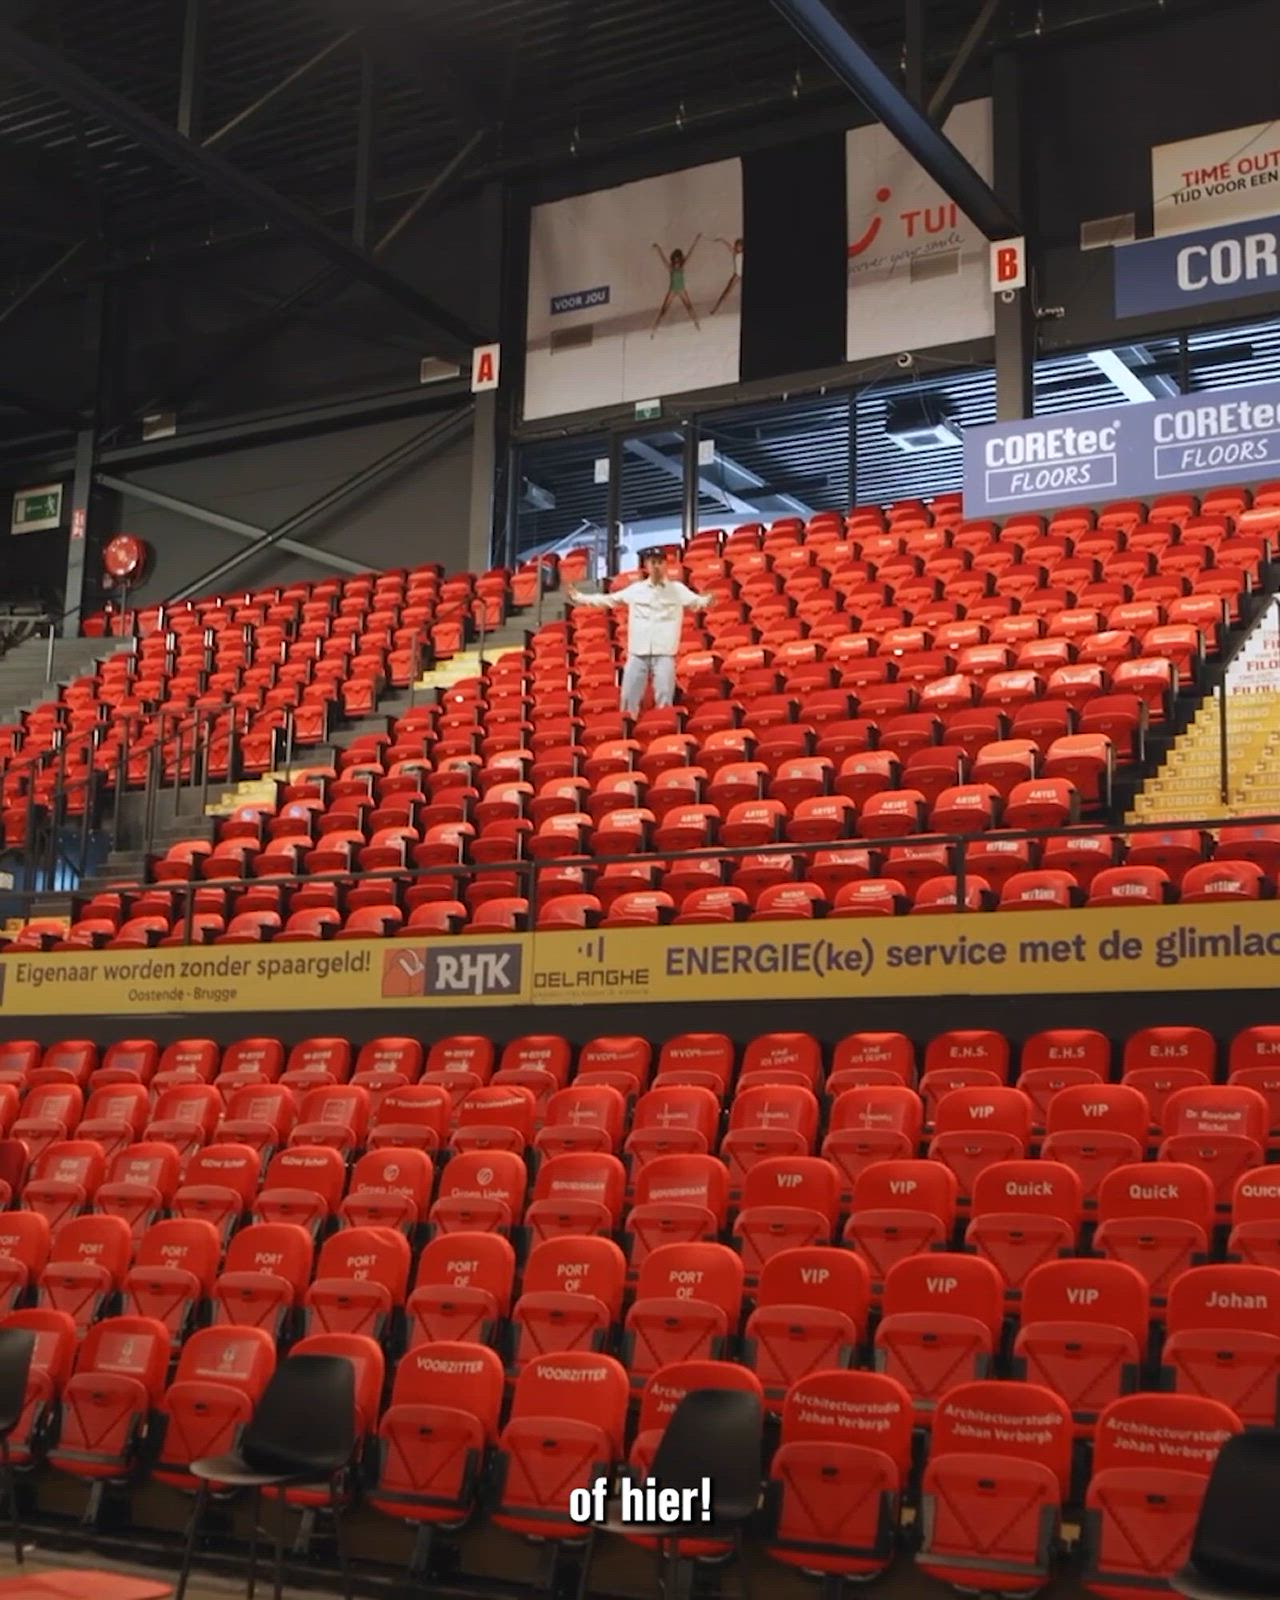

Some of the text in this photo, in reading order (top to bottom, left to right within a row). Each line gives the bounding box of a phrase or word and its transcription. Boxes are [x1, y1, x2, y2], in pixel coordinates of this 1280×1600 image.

[1182, 149, 1280, 188] TIME OUT
[1171, 169, 1279, 205] TIJD VOOR EEN
[899, 202, 958, 239] TUI
[996, 247, 1018, 283] B
[1176, 232, 1278, 292] COR
[554, 290, 607, 311] VOOR JOU
[476, 352, 494, 384] A
[985, 426, 1117, 468] COREtec
[1181, 438, 1269, 470] FLOORS
[1010, 463, 1092, 494] FLOORS
[666, 937, 875, 979] ENERGIE(ke)
[885, 934, 1007, 968] service
[1019, 932, 1086, 963] met
[1099, 929, 1143, 961] de
[15, 949, 372, 987] Eigenaar worden zonder spaargeld!
[434, 952, 512, 995] RHK
[533, 967, 650, 988] DELANGHE
[128, 986, 185, 1001] Oostende
[193, 985, 238, 1003] Brugge
[969, 1105, 995, 1118] VIP
[1081, 1103, 1109, 1117] VIP
[776, 1173, 803, 1188] VIP
[889, 1180, 917, 1195] VIP
[1005, 1181, 1053, 1196] Quick
[1129, 1184, 1179, 1199] Quick
[78, 1243, 104, 1254] PORT
[161, 1246, 188, 1257] PORT
[254, 1252, 284, 1265] PORT
[347, 1254, 377, 1269] PORT
[447, 1260, 479, 1274] PORT
[557, 1263, 590, 1278] PORT
[669, 1270, 704, 1285] PORT
[801, 1268, 831, 1285] VIP
[564, 1278, 582, 1292] OF
[676, 1286, 694, 1299] OF
[926, 1276, 958, 1294] VIP
[1066, 1287, 1100, 1305] VIP
[1205, 1291, 1269, 1309] Johan
[416, 1356, 485, 1374] VOORZITTER
[536, 1365, 609, 1383] VOORZITTER
[798, 1410, 837, 1427] Johan
[951, 1422, 992, 1440] Johan
[1113, 1435, 1156, 1453] Johan
